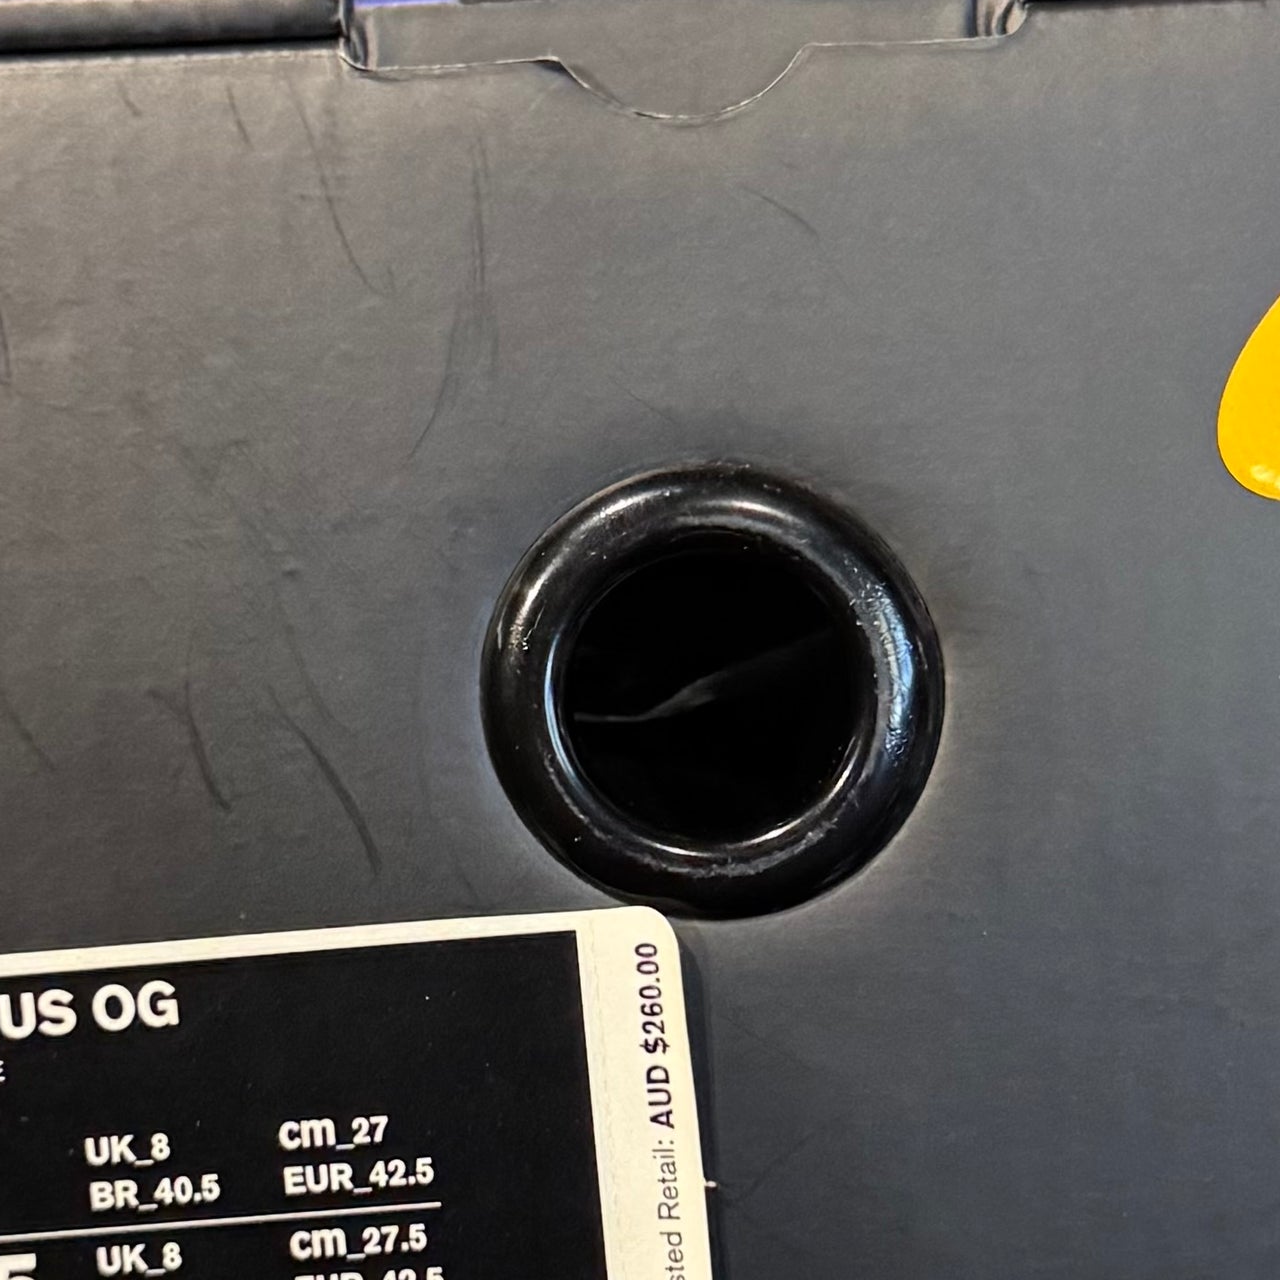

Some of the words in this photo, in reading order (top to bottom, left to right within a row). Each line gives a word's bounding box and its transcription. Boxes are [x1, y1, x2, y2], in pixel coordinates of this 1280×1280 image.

[93, 980, 179, 1032] OG
[635, 942, 671, 1054] $260.00
[646, 1065, 674, 1129] AUD
[84, 1133, 170, 1167] UK_8
[89, 1173, 220, 1212] BR_40.5
[283, 1157, 434, 1196] EUR_42.5
[652, 1139, 681, 1221] Retail:
[96, 1242, 182, 1277] UK_8
